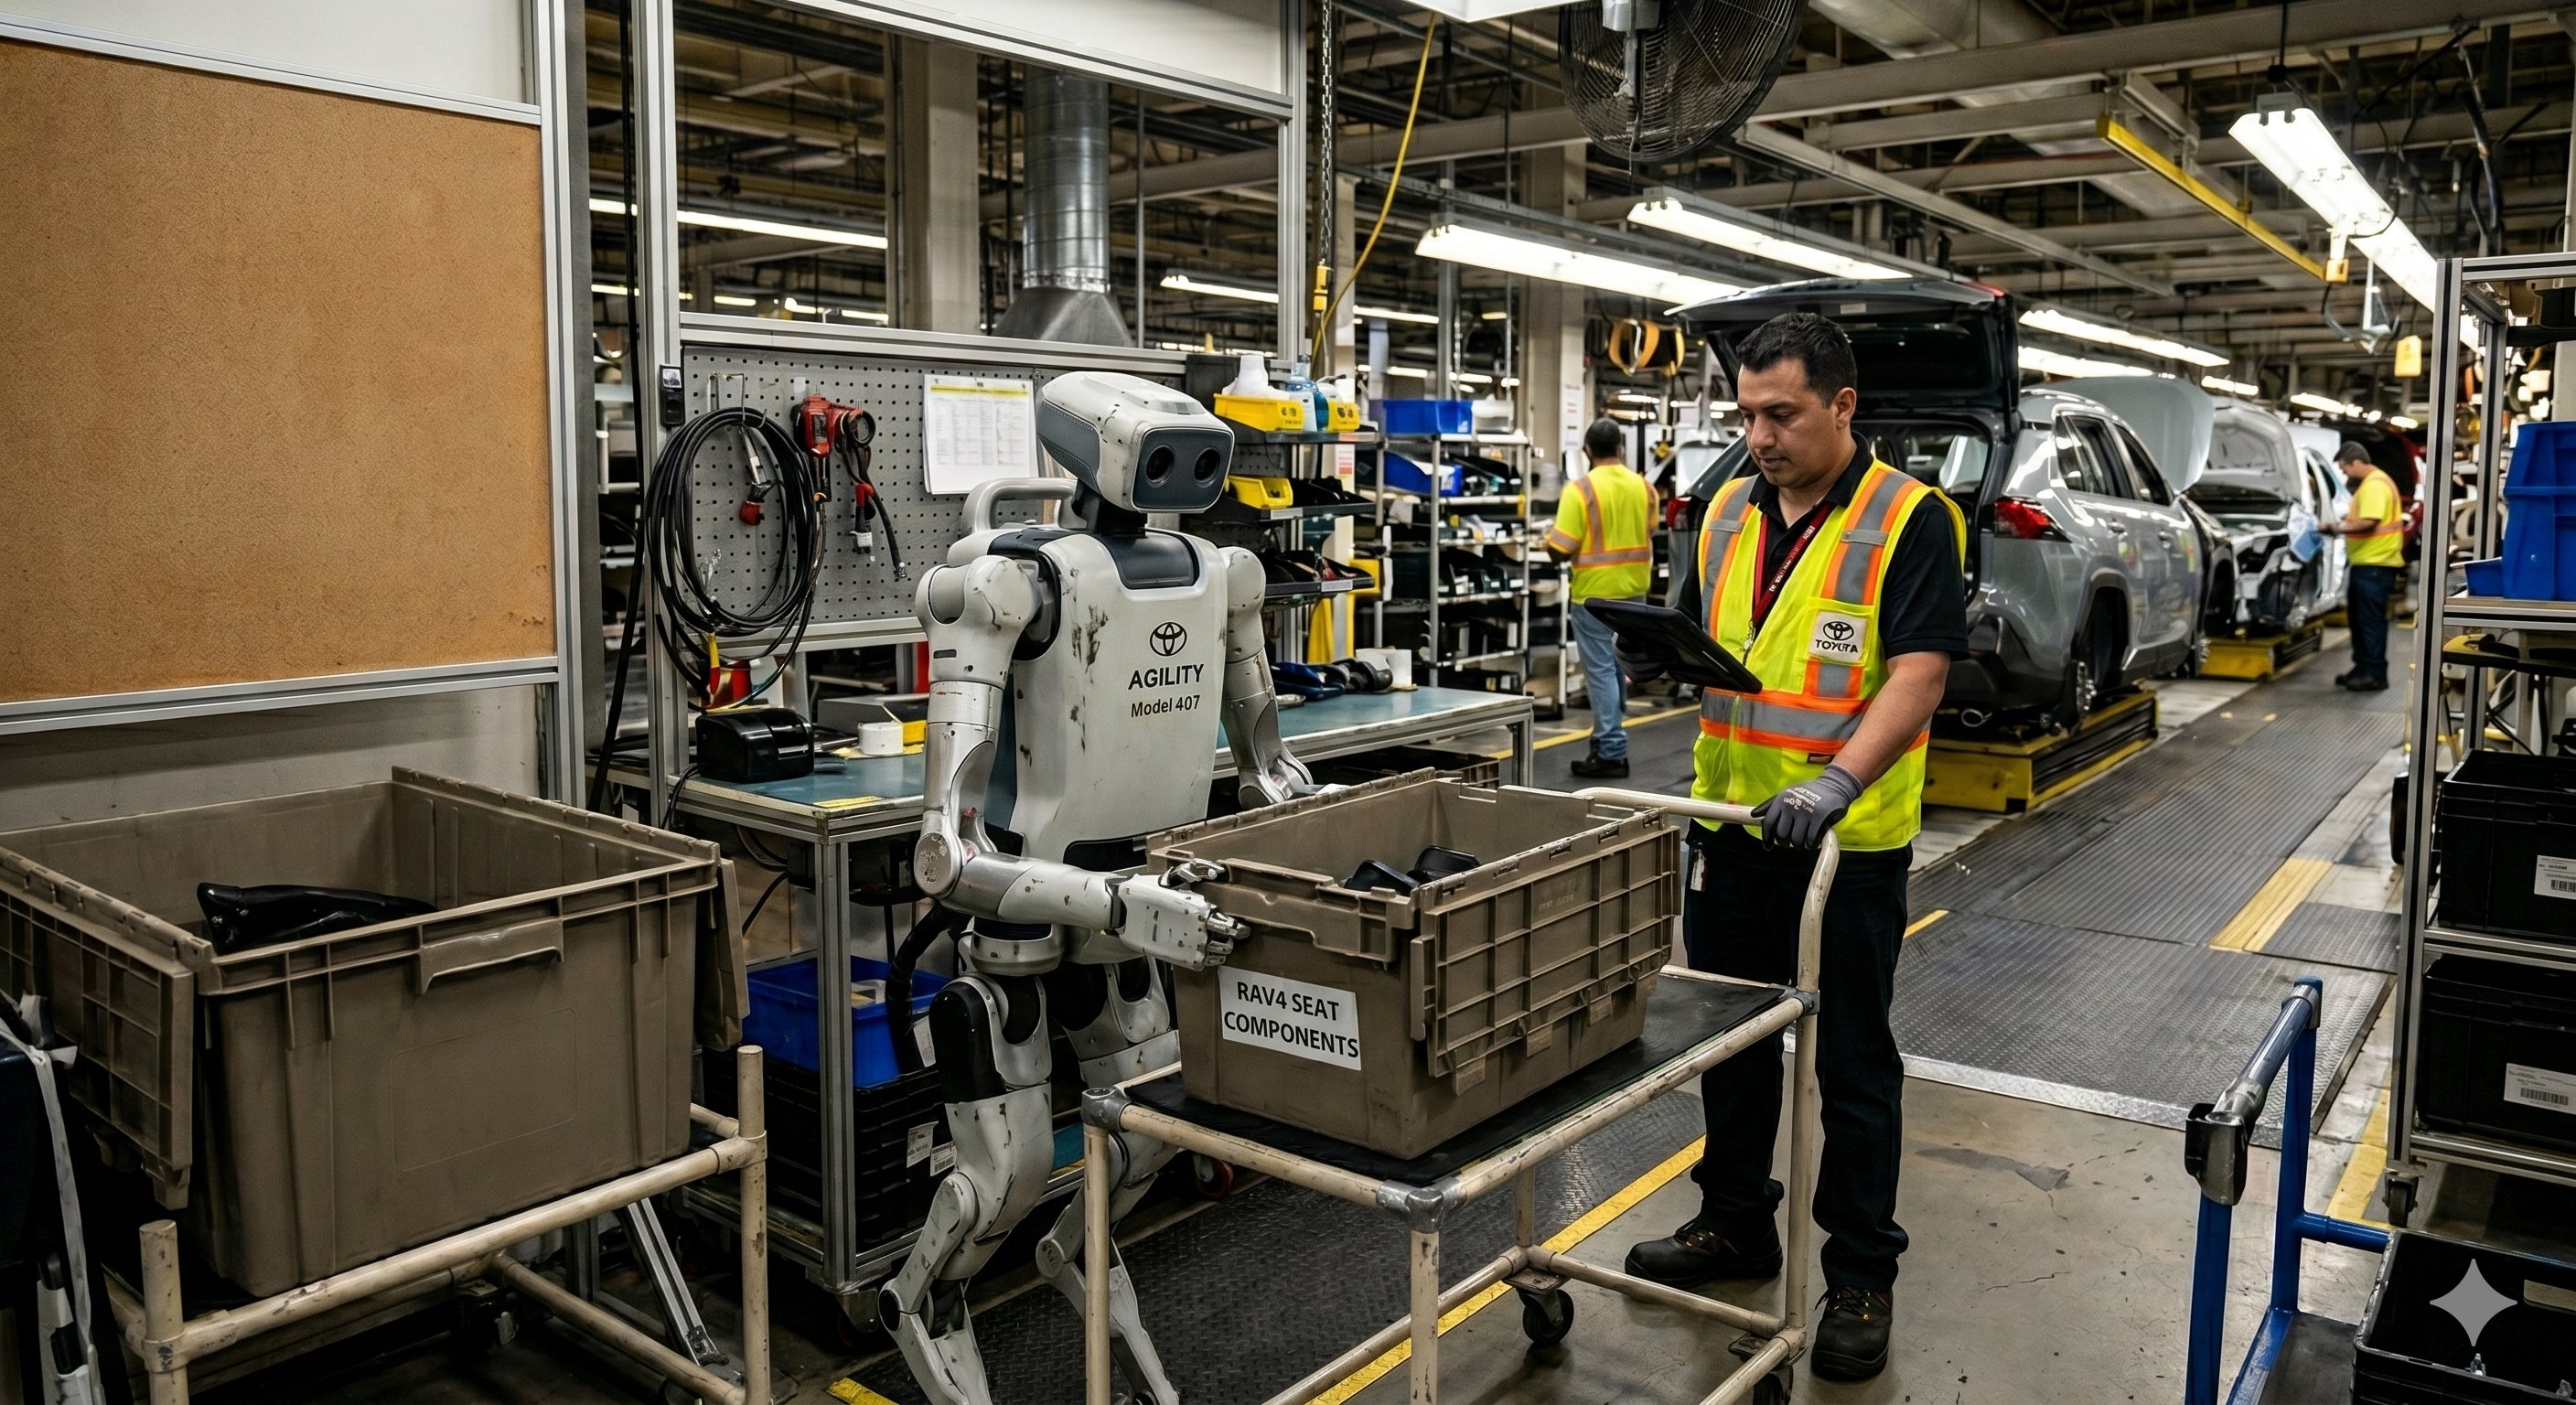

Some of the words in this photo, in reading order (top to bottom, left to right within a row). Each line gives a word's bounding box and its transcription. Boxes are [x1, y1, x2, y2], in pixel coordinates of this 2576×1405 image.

[1127, 663, 1205, 691] AGILITY
[1131, 698, 1173, 718] Model
[1175, 694, 1200, 712] 407
[1237, 981, 1287, 1010] RAV4
[1292, 992, 1339, 1022] SEAT
[1224, 1011, 1359, 1058] COMPONENTS
